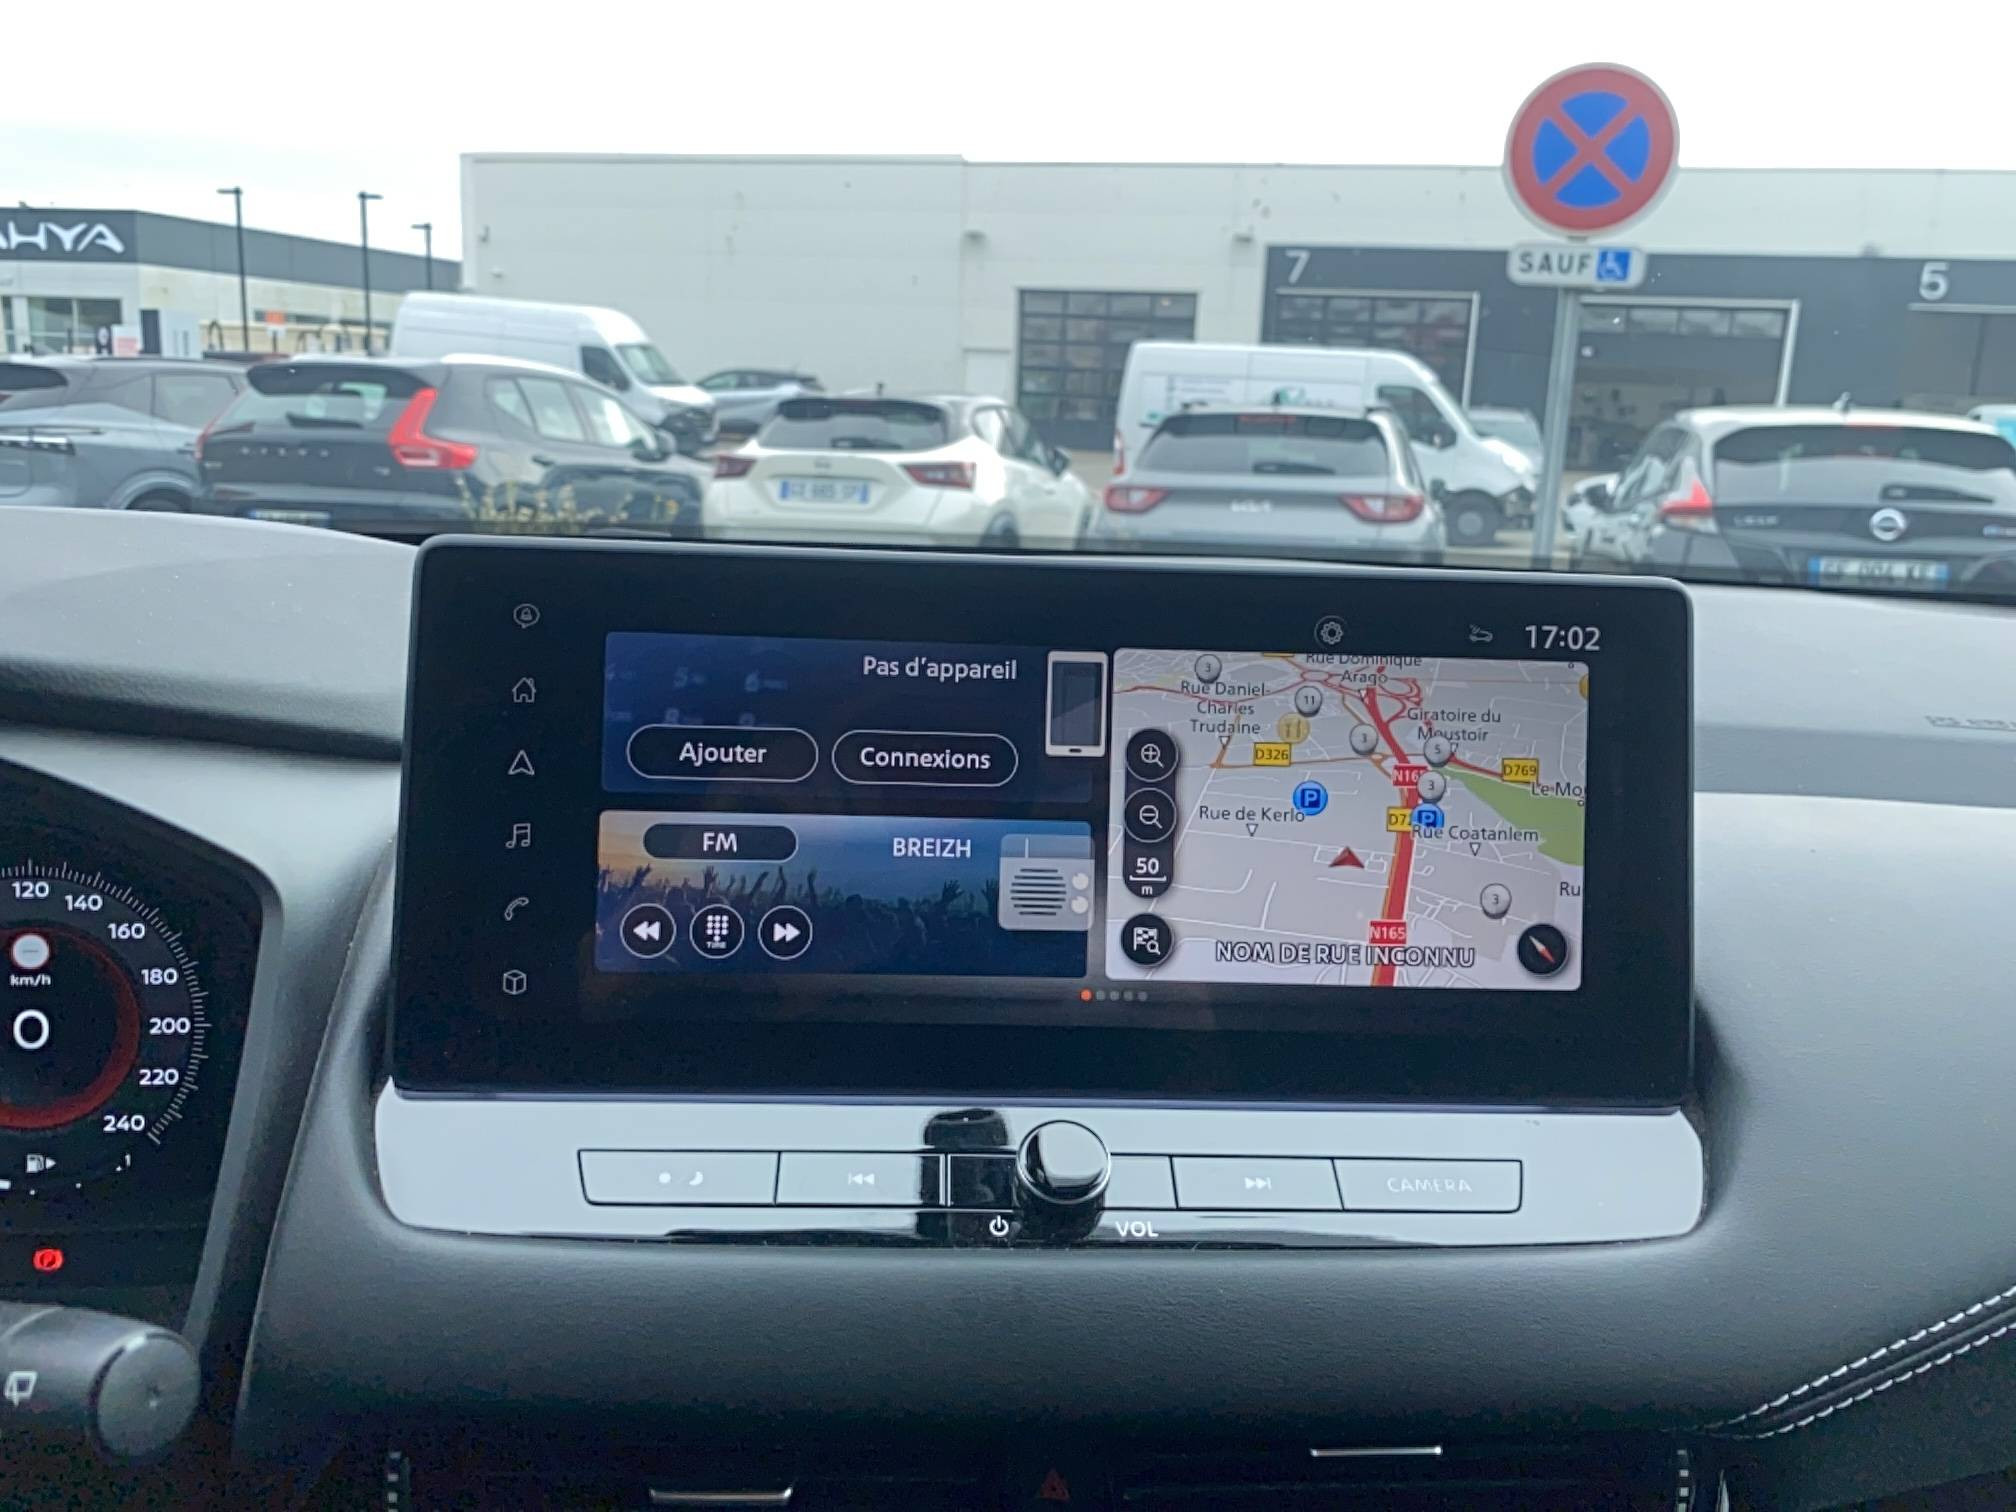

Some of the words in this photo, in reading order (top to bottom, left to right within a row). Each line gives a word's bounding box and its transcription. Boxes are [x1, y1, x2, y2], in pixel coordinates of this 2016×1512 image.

[0, 221, 125, 253] HYA
[1286, 250, 1310, 284] 7
[1518, 251, 1592, 275] SAUF
[1919, 262, 1949, 300] 5
[1525, 625, 1600, 651] 17:02
[863, 656, 900, 677] Pas
[905, 657, 1018, 683] d'appareil
[1306, 654, 1335, 664] Rue
[1340, 655, 1422, 670] Dominique
[1341, 670, 1389, 686] Arago
[1181, 681, 1211, 695] Rue
[1197, 701, 1255, 715] Charles
[1408, 708, 1477, 723] Giratoire
[1481, 708, 1501, 723] du
[1190, 719, 1261, 734] Trudaine
[679, 742, 767, 768] Ajouter
[860, 748, 991, 770] Connexions
[1256, 748, 1289, 761] D326
[1504, 764, 1537, 776] D769
[1200, 806, 1231, 820] Rue
[1235, 806, 1257, 821] de
[1261, 807, 1305, 822] Kerlo
[1413, 825, 1443, 839] Rue
[1449, 826, 1539, 842] Coatanlem
[703, 833, 738, 853] FM
[893, 838, 972, 859] BREIZH
[1136, 857, 1160, 874] 50
[11, 882, 50, 899] 120
[1141, 885, 1153, 895] m
[65, 895, 103, 911] 140
[108, 923, 145, 939] 160
[1370, 926, 1406, 939] N165
[1216, 941, 1274, 962] NOM
[1280, 943, 1310, 964] DE
[1316, 944, 1361, 966] RUE
[1366, 946, 1475, 968] INCONNU
[10, 973, 51, 988] km/h
[141, 968, 178, 985] 180
[13, 1009, 50, 1050] 0
[150, 1017, 191, 1034] 200
[139, 1069, 179, 1086] 220
[103, 1115, 145, 1132] 240
[1387, 1176, 1473, 1194] CAMERA
[1116, 1221, 1158, 1238] VOL
